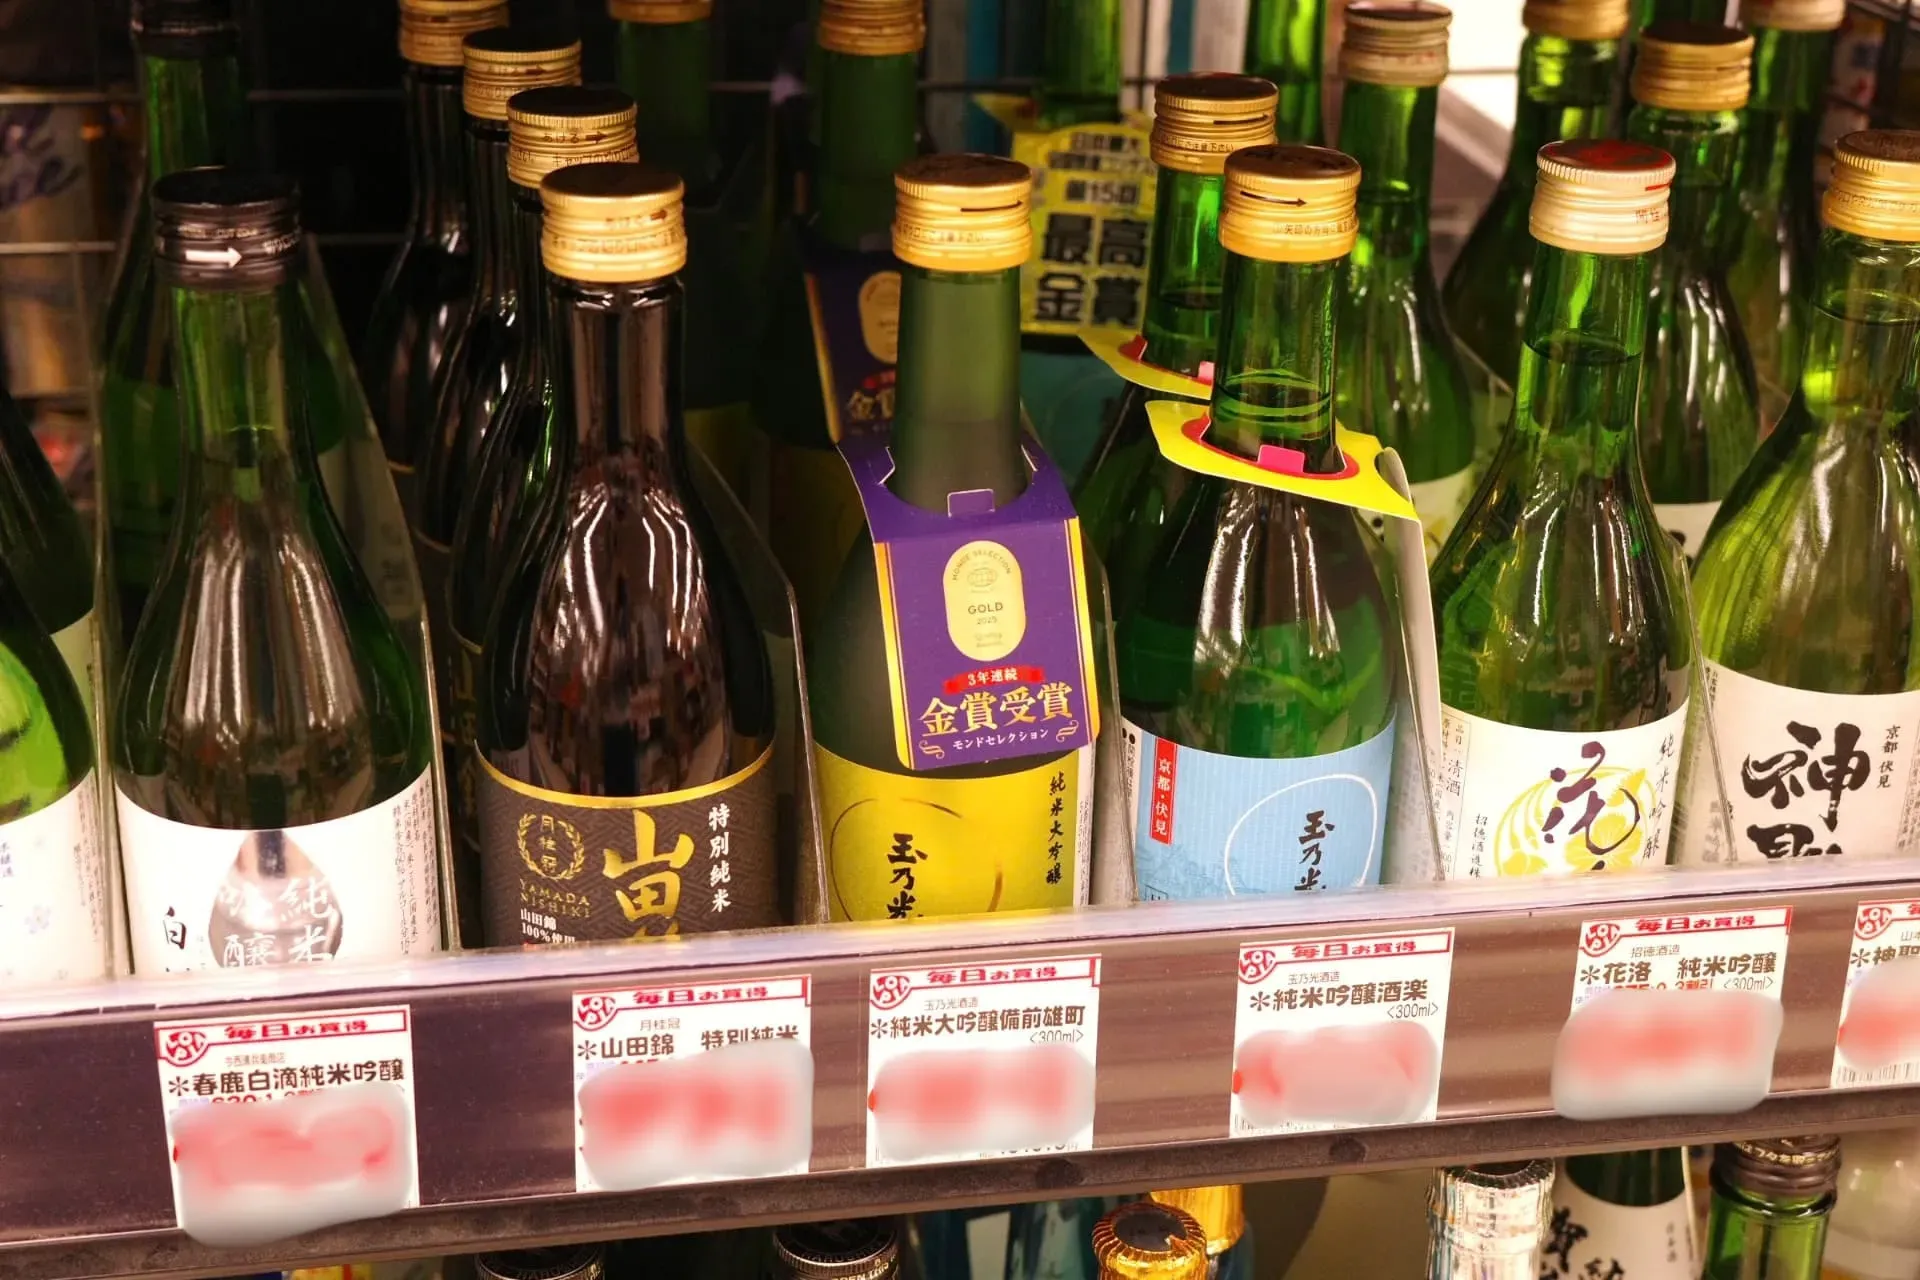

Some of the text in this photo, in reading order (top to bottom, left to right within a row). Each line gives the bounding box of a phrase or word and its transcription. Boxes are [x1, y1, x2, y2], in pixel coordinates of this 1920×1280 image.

[968, 601, 1004, 615] GOLD
[967, 667, 1018, 686] 3年連続
[918, 681, 1073, 737] 金賞受賞
[952, 728, 1049, 750] モンドセレクション
[1445, 760, 1464, 797] 清酒
[1154, 757, 1172, 837] 京都・伏見
[1045, 771, 1067, 885] 純米大吟醸
[708, 803, 732, 913] 特別純米
[602, 809, 695, 941] 山田
[519, 878, 591, 906] YAMADA
[520, 908, 558, 931] 山田錦
[1635, 915, 1755, 932] 毎日お買得
[1291, 940, 1417, 959] 毎日お買得
[1631, 944, 1681, 958] 招徳酒造
[927, 965, 1058, 984] 毎日お買得
[1288, 971, 1340, 986] 玉乃光酒造
[1602, 951, 1778, 985] 花洛 純米吟醸
[633, 986, 769, 1005] 毎日お買得
[924, 996, 979, 1012] 玉乃光酒造
[1272, 978, 1429, 1012] 純米吟醸酒楽
[224, 1020, 369, 1040] 毎日お買得
[640, 1017, 681, 1032] 月桂冠
[889, 1004, 1086, 1040] 純米大吟醸備前雄町
[600, 1033, 675, 1059] 山田錦
[191, 1058, 405, 1097] 春鹿白滴純米吟醸
